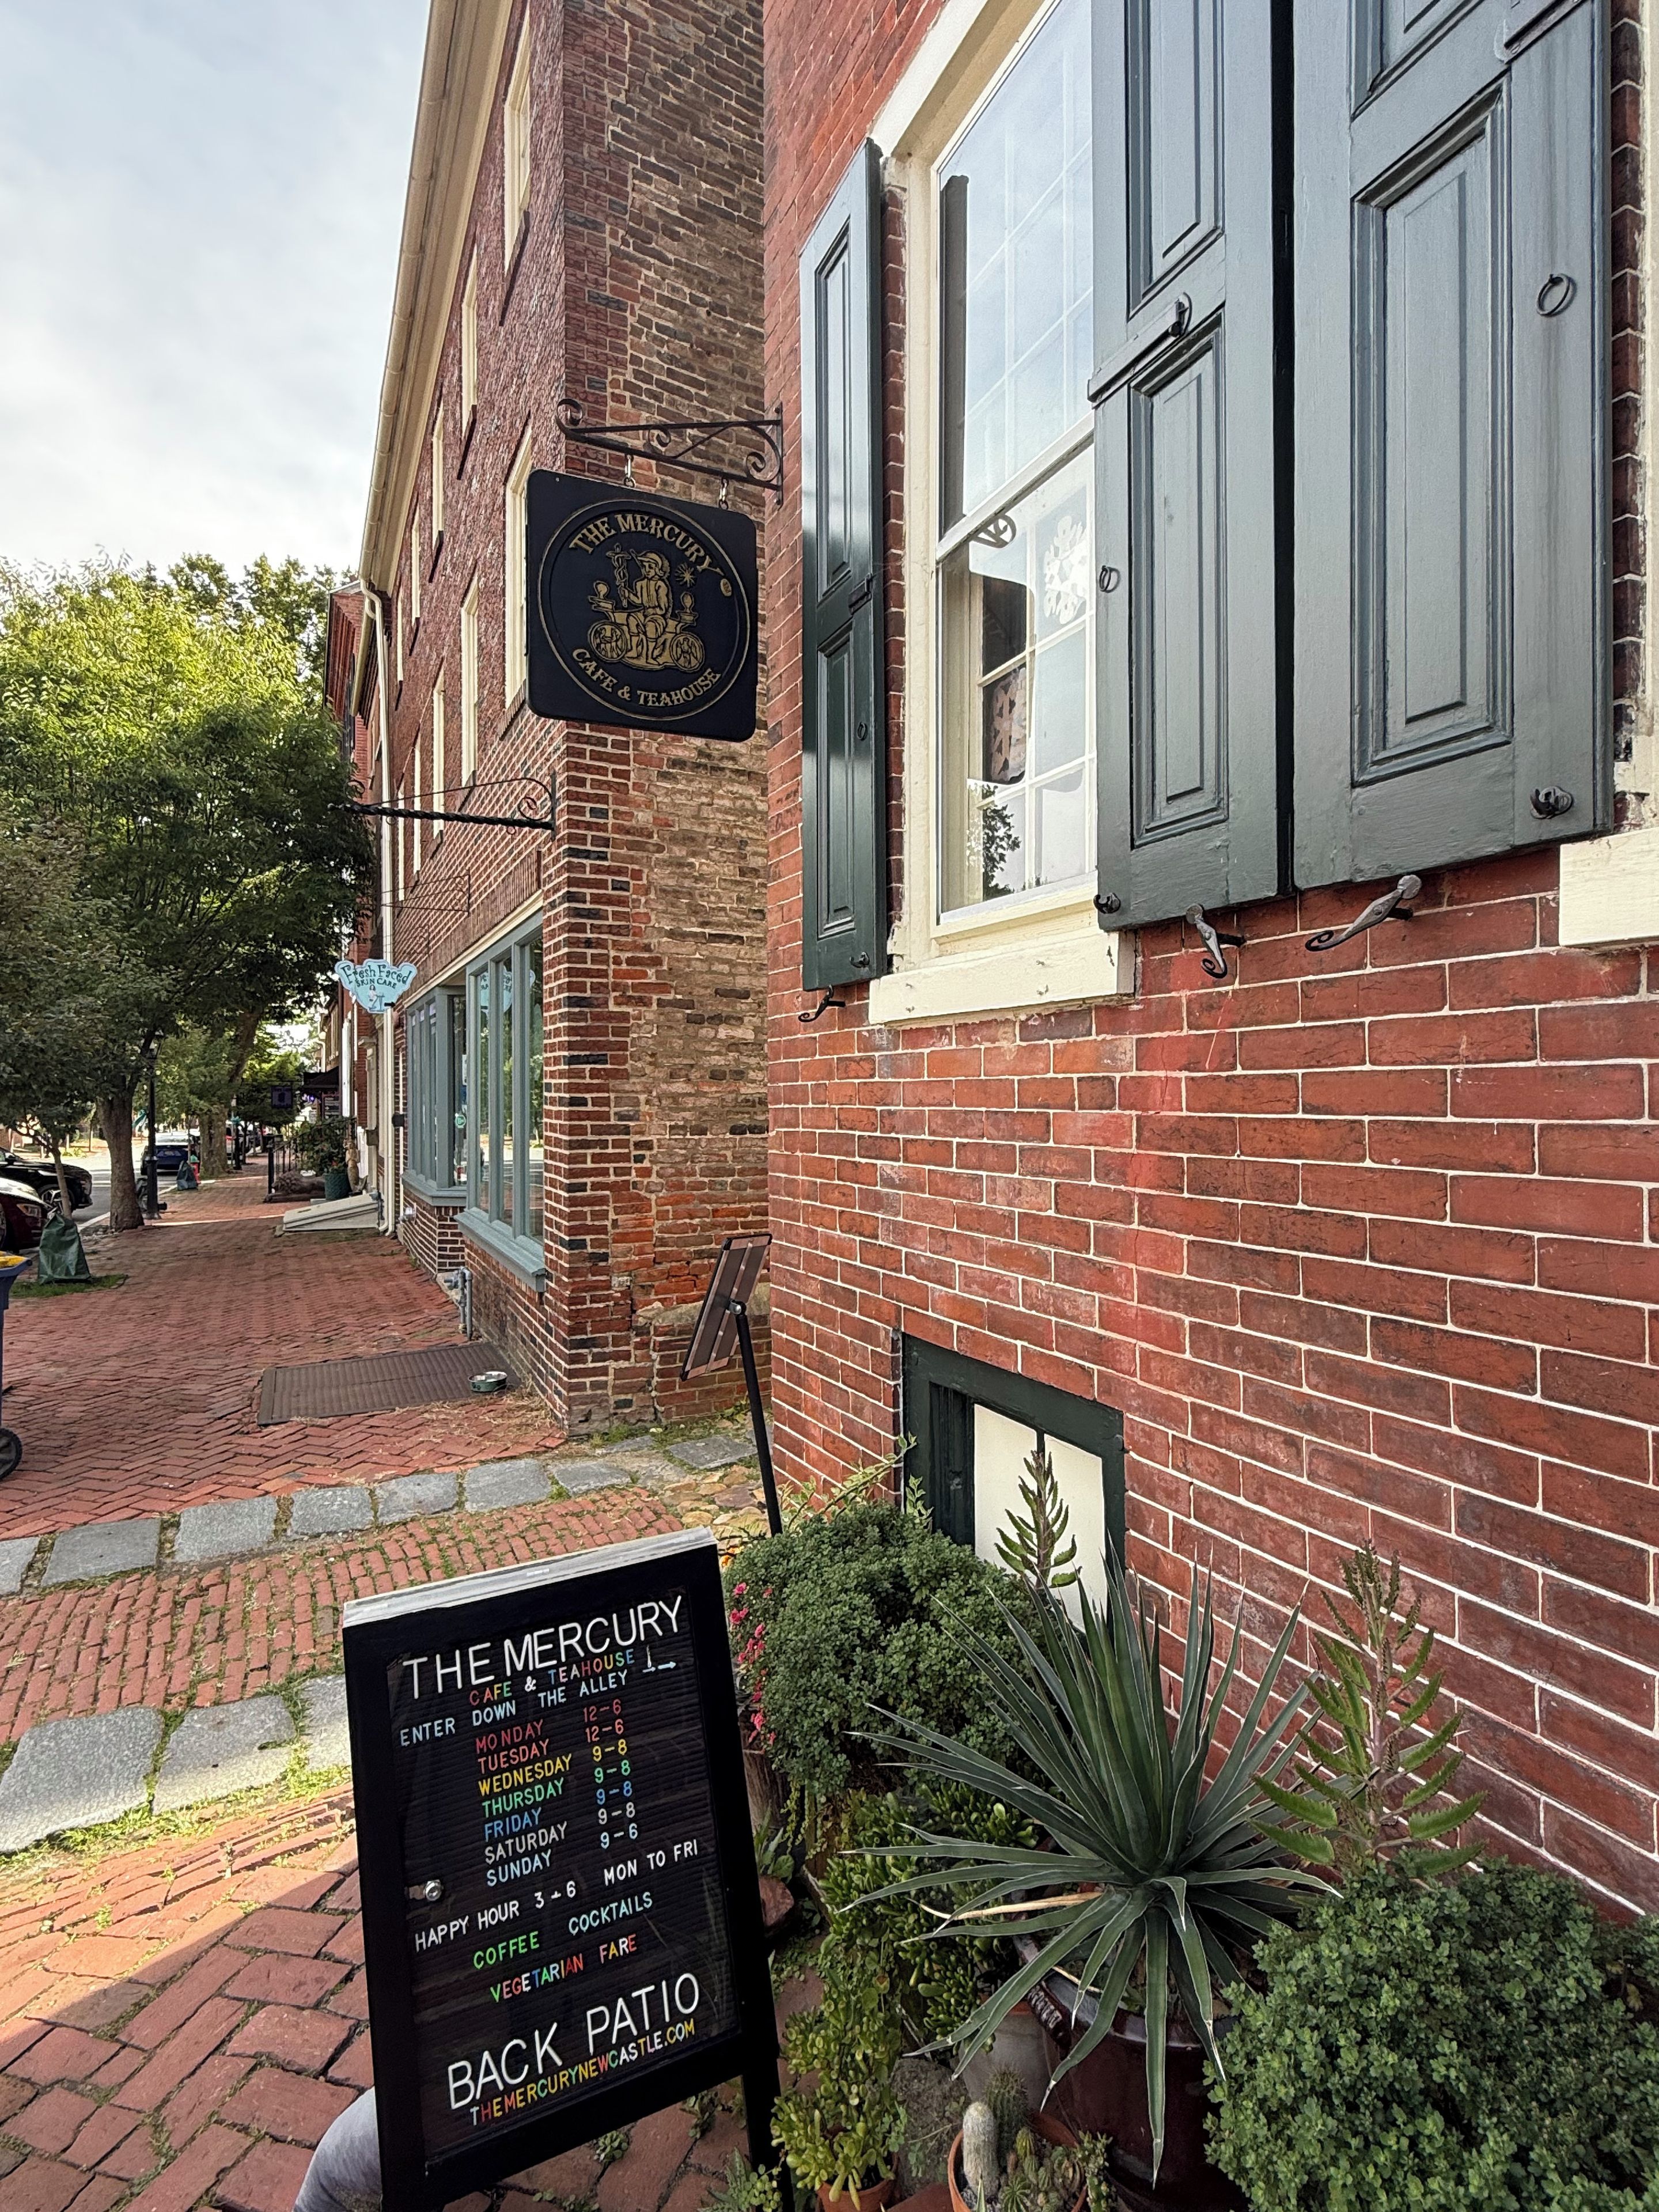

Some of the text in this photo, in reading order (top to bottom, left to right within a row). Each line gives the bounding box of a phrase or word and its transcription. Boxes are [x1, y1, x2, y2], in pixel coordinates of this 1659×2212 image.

[569, 513, 724, 575] THE MERCURY
[572, 648, 722, 707] CAFE & TEAHOUSE
[340, 964, 412, 985] Fresh Faced
[355, 978, 397, 989] SKIN CARE
[403, 1595, 683, 1699] THE MERCURY
[469, 1649, 635, 1706] CAFE & TEAHOUSE
[400, 1669, 628, 1747] ENTER DOWN THE ALLEY
[476, 1720, 543, 1752] MONDAY
[478, 1740, 550, 1775] TUESDAY
[478, 1753, 572, 1796] WEDNESDAY
[482, 1778, 564, 1819] THURSDAY
[484, 1807, 542, 1842] FRIDAY
[484, 1821, 568, 1865] SATURDAY
[487, 1849, 552, 1887] SUNDAY
[415, 1915, 469, 1953] HAPPY
[478, 1900, 520, 1930] HOUR
[604, 1860, 638, 1887] MON
[647, 1850, 666, 1871] TO
[674, 1839, 699, 1863] FRI
[474, 1892, 653, 1969] COFFEE COCKTAILS
[490, 1934, 638, 2003] VEGETARIAN FARE
[447, 1973, 700, 2110] BACK PATIO
[469, 2018, 695, 2126] THEMERCURYNEWCASTLE.COM
